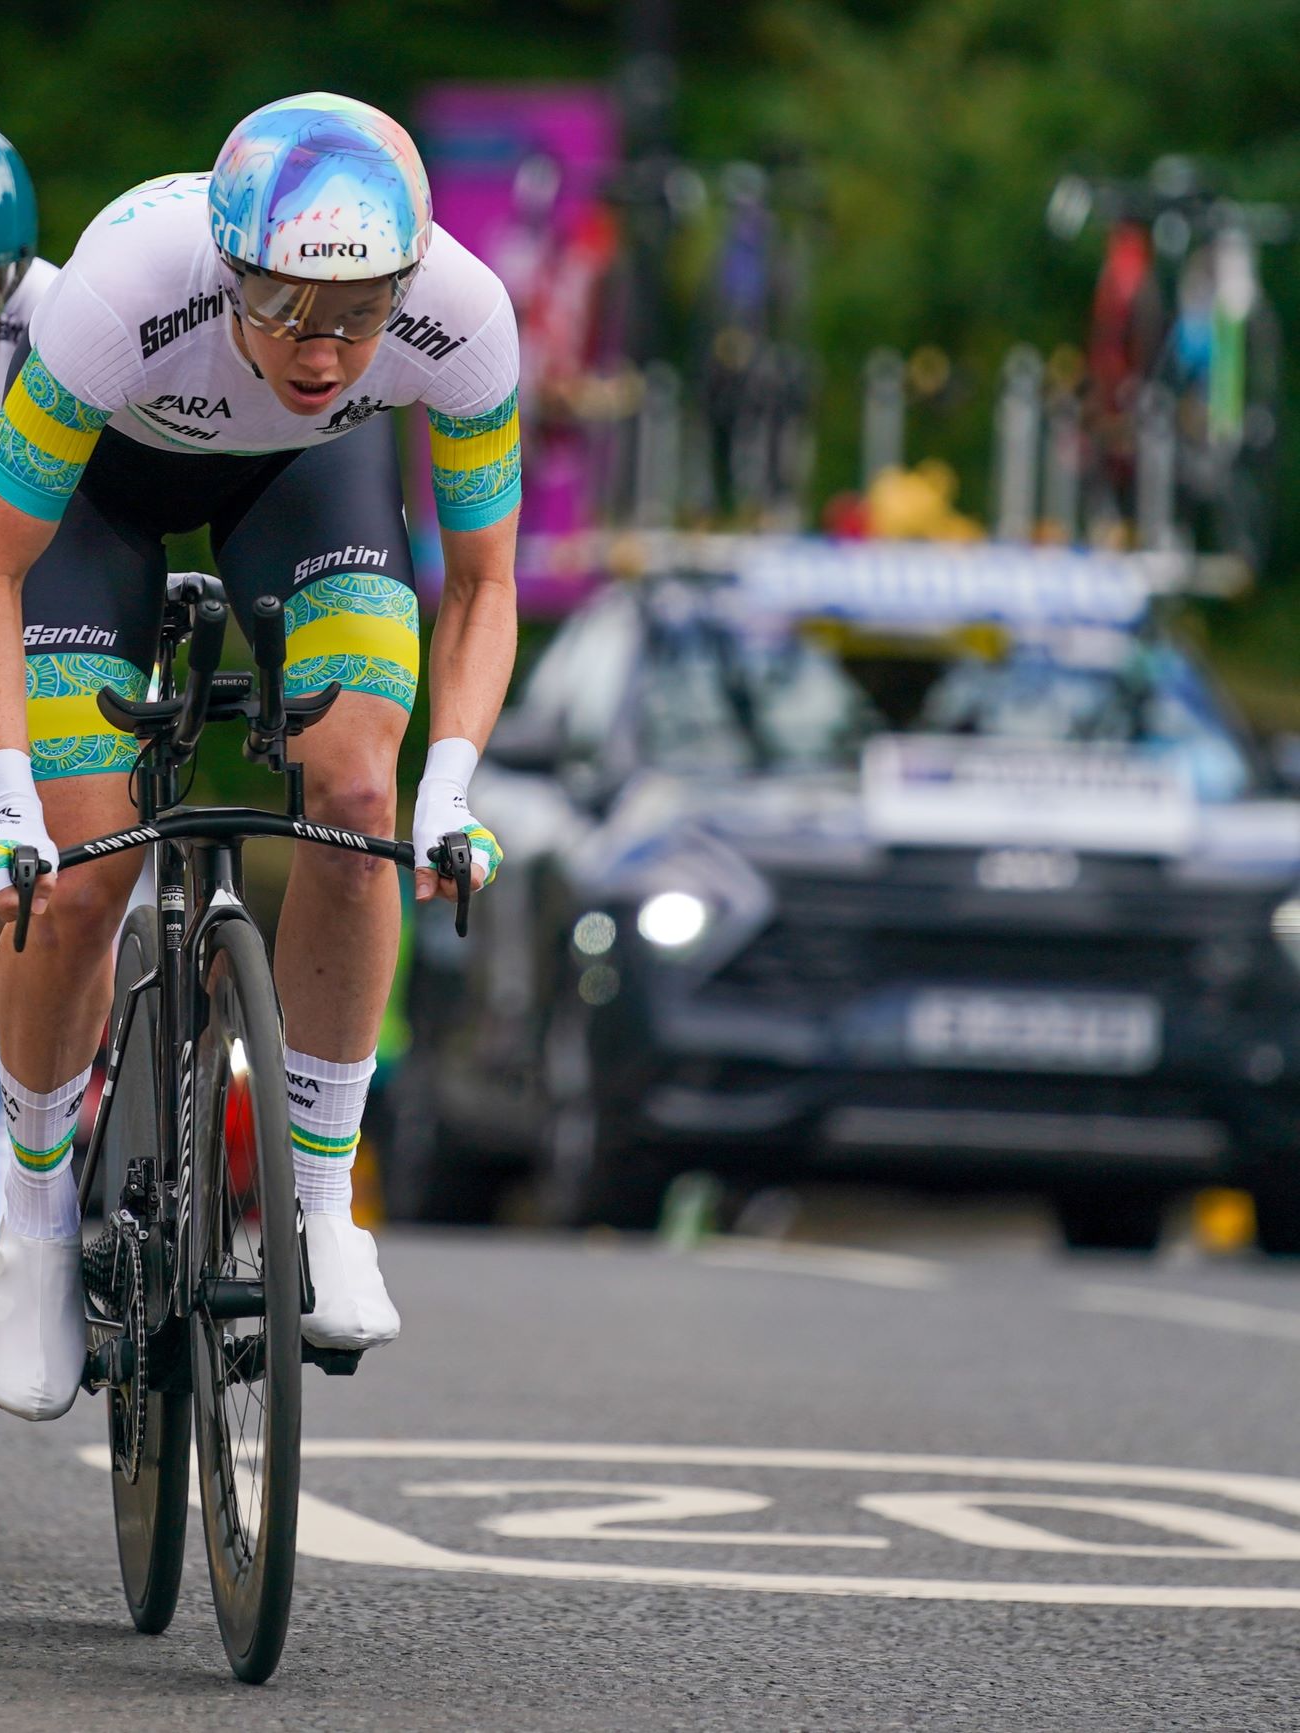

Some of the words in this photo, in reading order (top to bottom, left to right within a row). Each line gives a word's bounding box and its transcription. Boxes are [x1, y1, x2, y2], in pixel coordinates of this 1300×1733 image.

[300, 242, 368, 258] GIRO
[139, 284, 224, 360] Santini
[386, 308, 468, 361] ntini
[293, 545, 389, 585] Santini
[22, 624, 118, 647] Santini
[211, 678, 250, 687] MERHEAD
[83, 827, 161, 855] CANYON
[292, 821, 369, 851] CANYON
[287, 1090, 316, 1109] ntini
[402, 1482, 1300, 1561] 20
